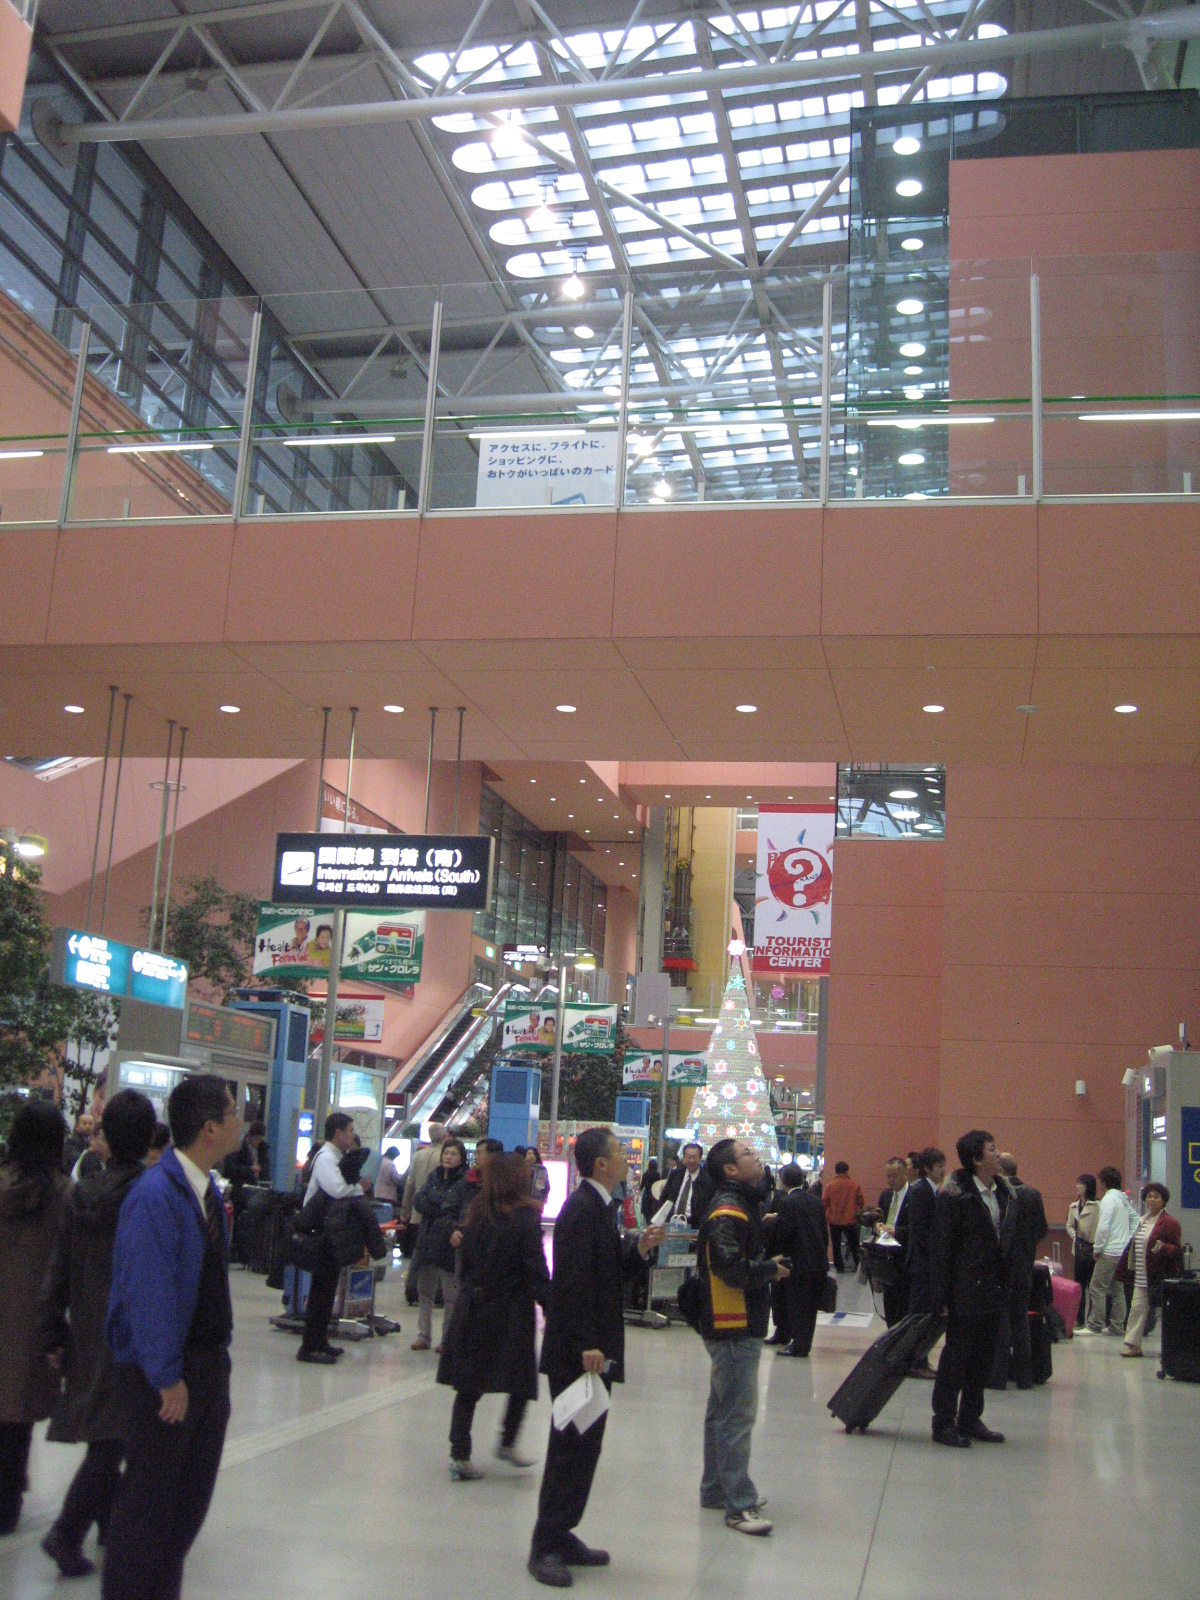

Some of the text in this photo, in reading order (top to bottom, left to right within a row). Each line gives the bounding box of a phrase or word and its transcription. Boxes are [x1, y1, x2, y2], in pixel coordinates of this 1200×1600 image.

[316, 866, 481, 884] International Arrivals (South)
[765, 936, 831, 947] TOURIST
[769, 957, 822, 968] CENTER
